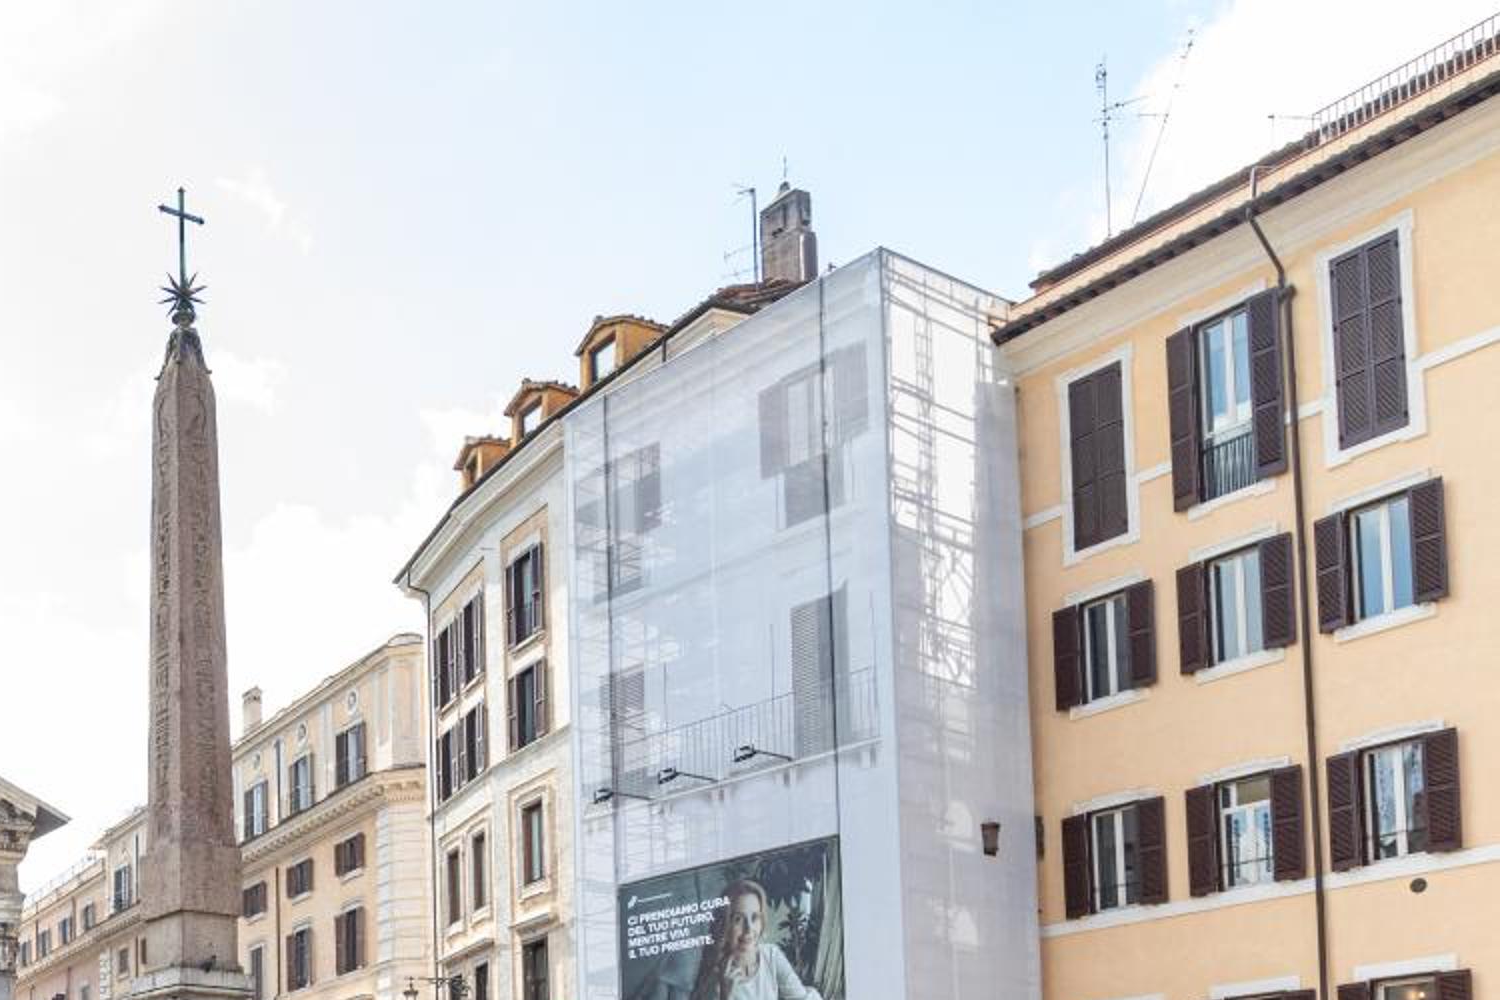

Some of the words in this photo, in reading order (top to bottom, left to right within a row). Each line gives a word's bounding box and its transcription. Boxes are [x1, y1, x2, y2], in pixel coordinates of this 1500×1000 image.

[640, 903, 698, 922] PRENDIAMO
[700, 896, 730, 910] CURA
[628, 926, 646, 937] DEL
[648, 921, 668, 932] TUO
[628, 932, 668, 947] MENTRE
[670, 928, 690, 940] VIVI
[628, 949, 636, 959] IL
[639, 945, 659, 956] TUO
